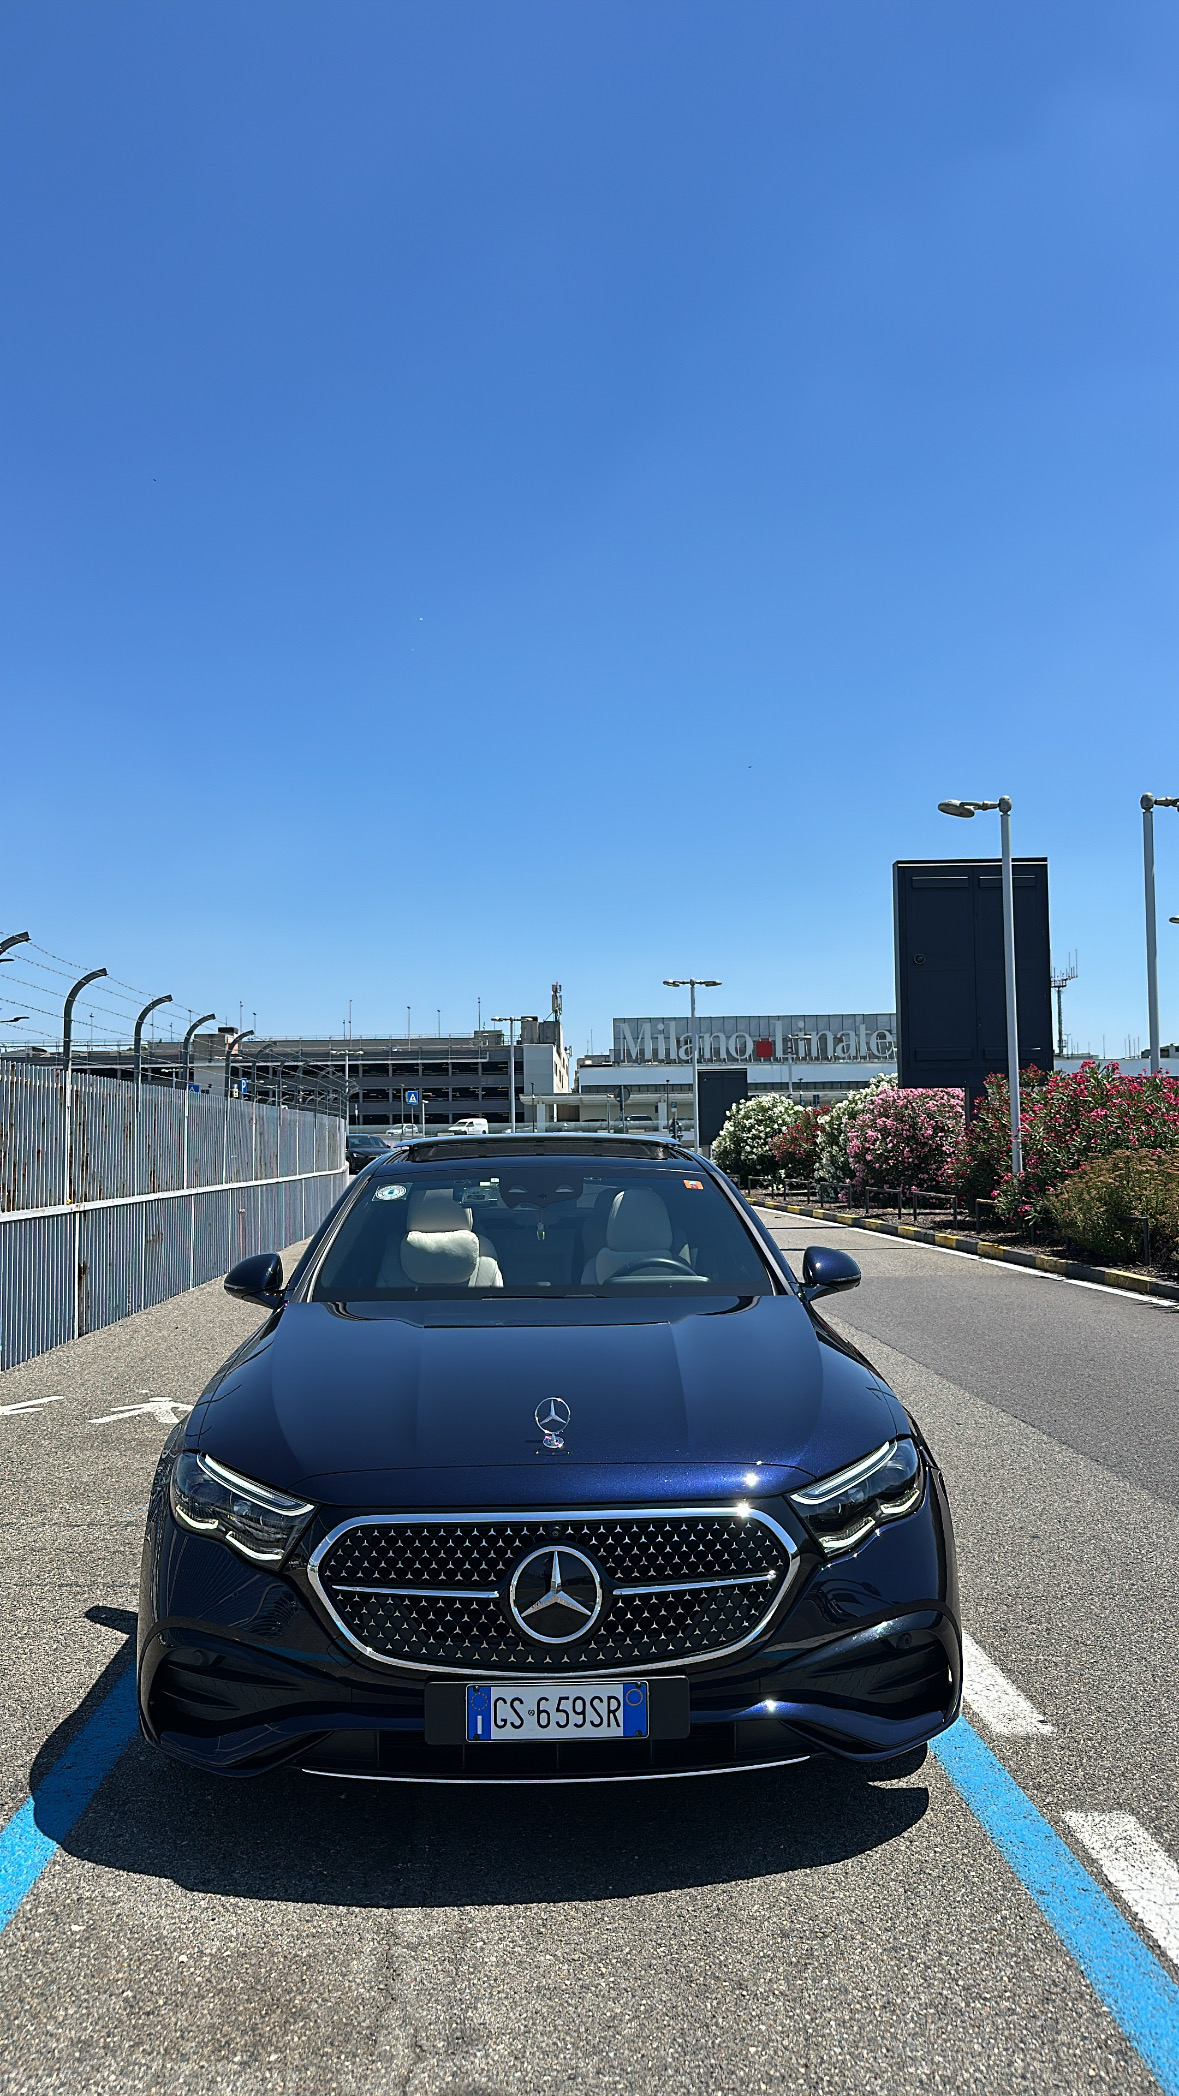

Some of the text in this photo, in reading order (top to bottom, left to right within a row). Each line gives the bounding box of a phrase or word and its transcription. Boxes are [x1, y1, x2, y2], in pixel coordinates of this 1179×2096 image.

[618, 1020, 894, 1060] Milano Linate
[493, 1695, 622, 1730] GS 659SR
